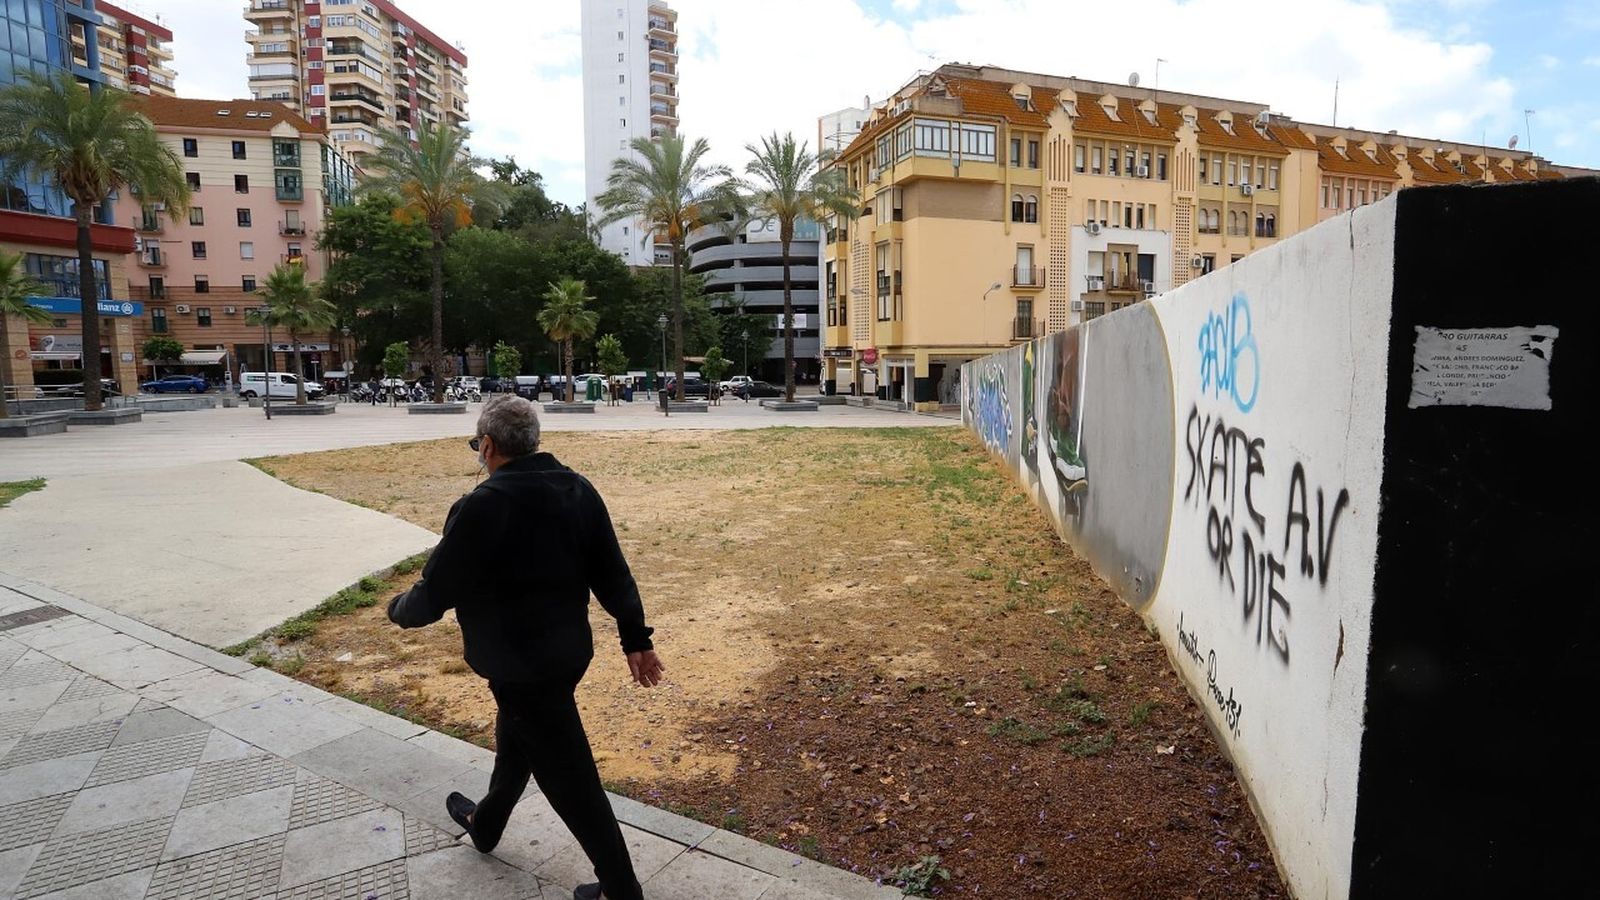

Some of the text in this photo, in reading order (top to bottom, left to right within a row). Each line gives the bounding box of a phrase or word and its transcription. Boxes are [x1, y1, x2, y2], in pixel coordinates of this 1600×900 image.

[1456, 333, 1509, 341] GUITARRAS
[1184, 400, 1266, 537] SKATE
[1206, 502, 1291, 667] OR DIE
